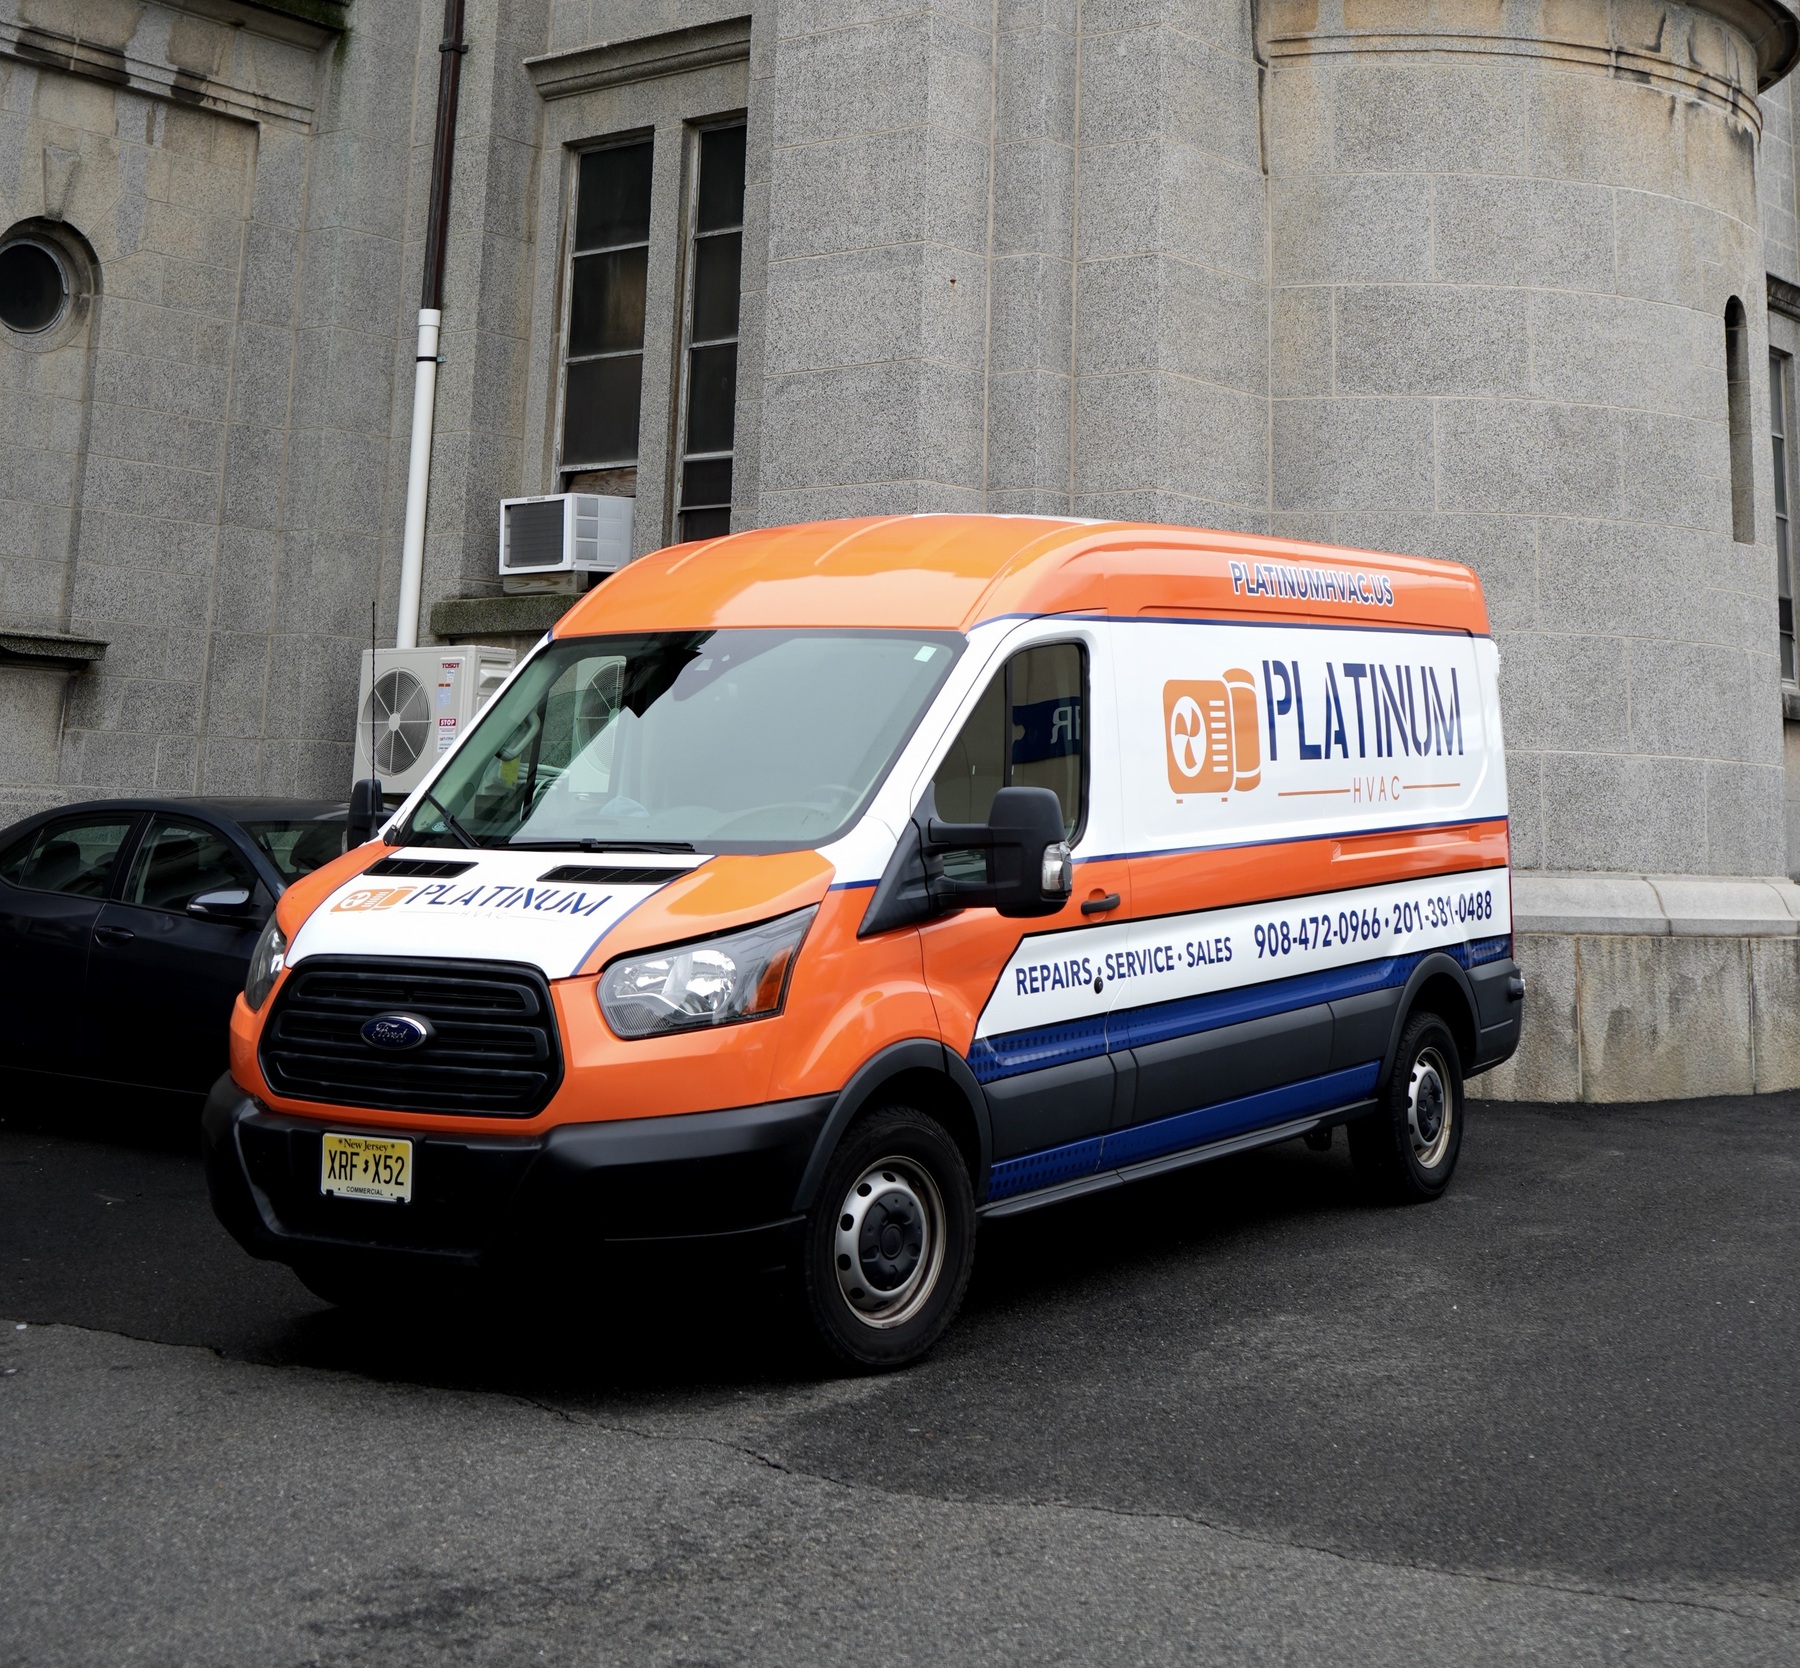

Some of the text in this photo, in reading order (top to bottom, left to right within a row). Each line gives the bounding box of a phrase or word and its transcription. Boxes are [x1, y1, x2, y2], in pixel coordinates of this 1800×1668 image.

[1229, 561, 1394, 606] PLATINUMHVAC.US
[1262, 660, 1464, 761] PLATINUM
[1353, 776, 1400, 803] HVAC
[405, 884, 613, 917] PLATINUM
[1254, 890, 1493, 959] 908-472-0966 201-381-0488
[1015, 936, 1233, 996] REPAIRS SERVICE SALES
[372, 1022, 408, 1043] Ford
[344, 1138, 388, 1153] New Jersey
[328, 1149, 405, 1186] XRF X52
[346, 1186, 383, 1196] COMMERCIAL
